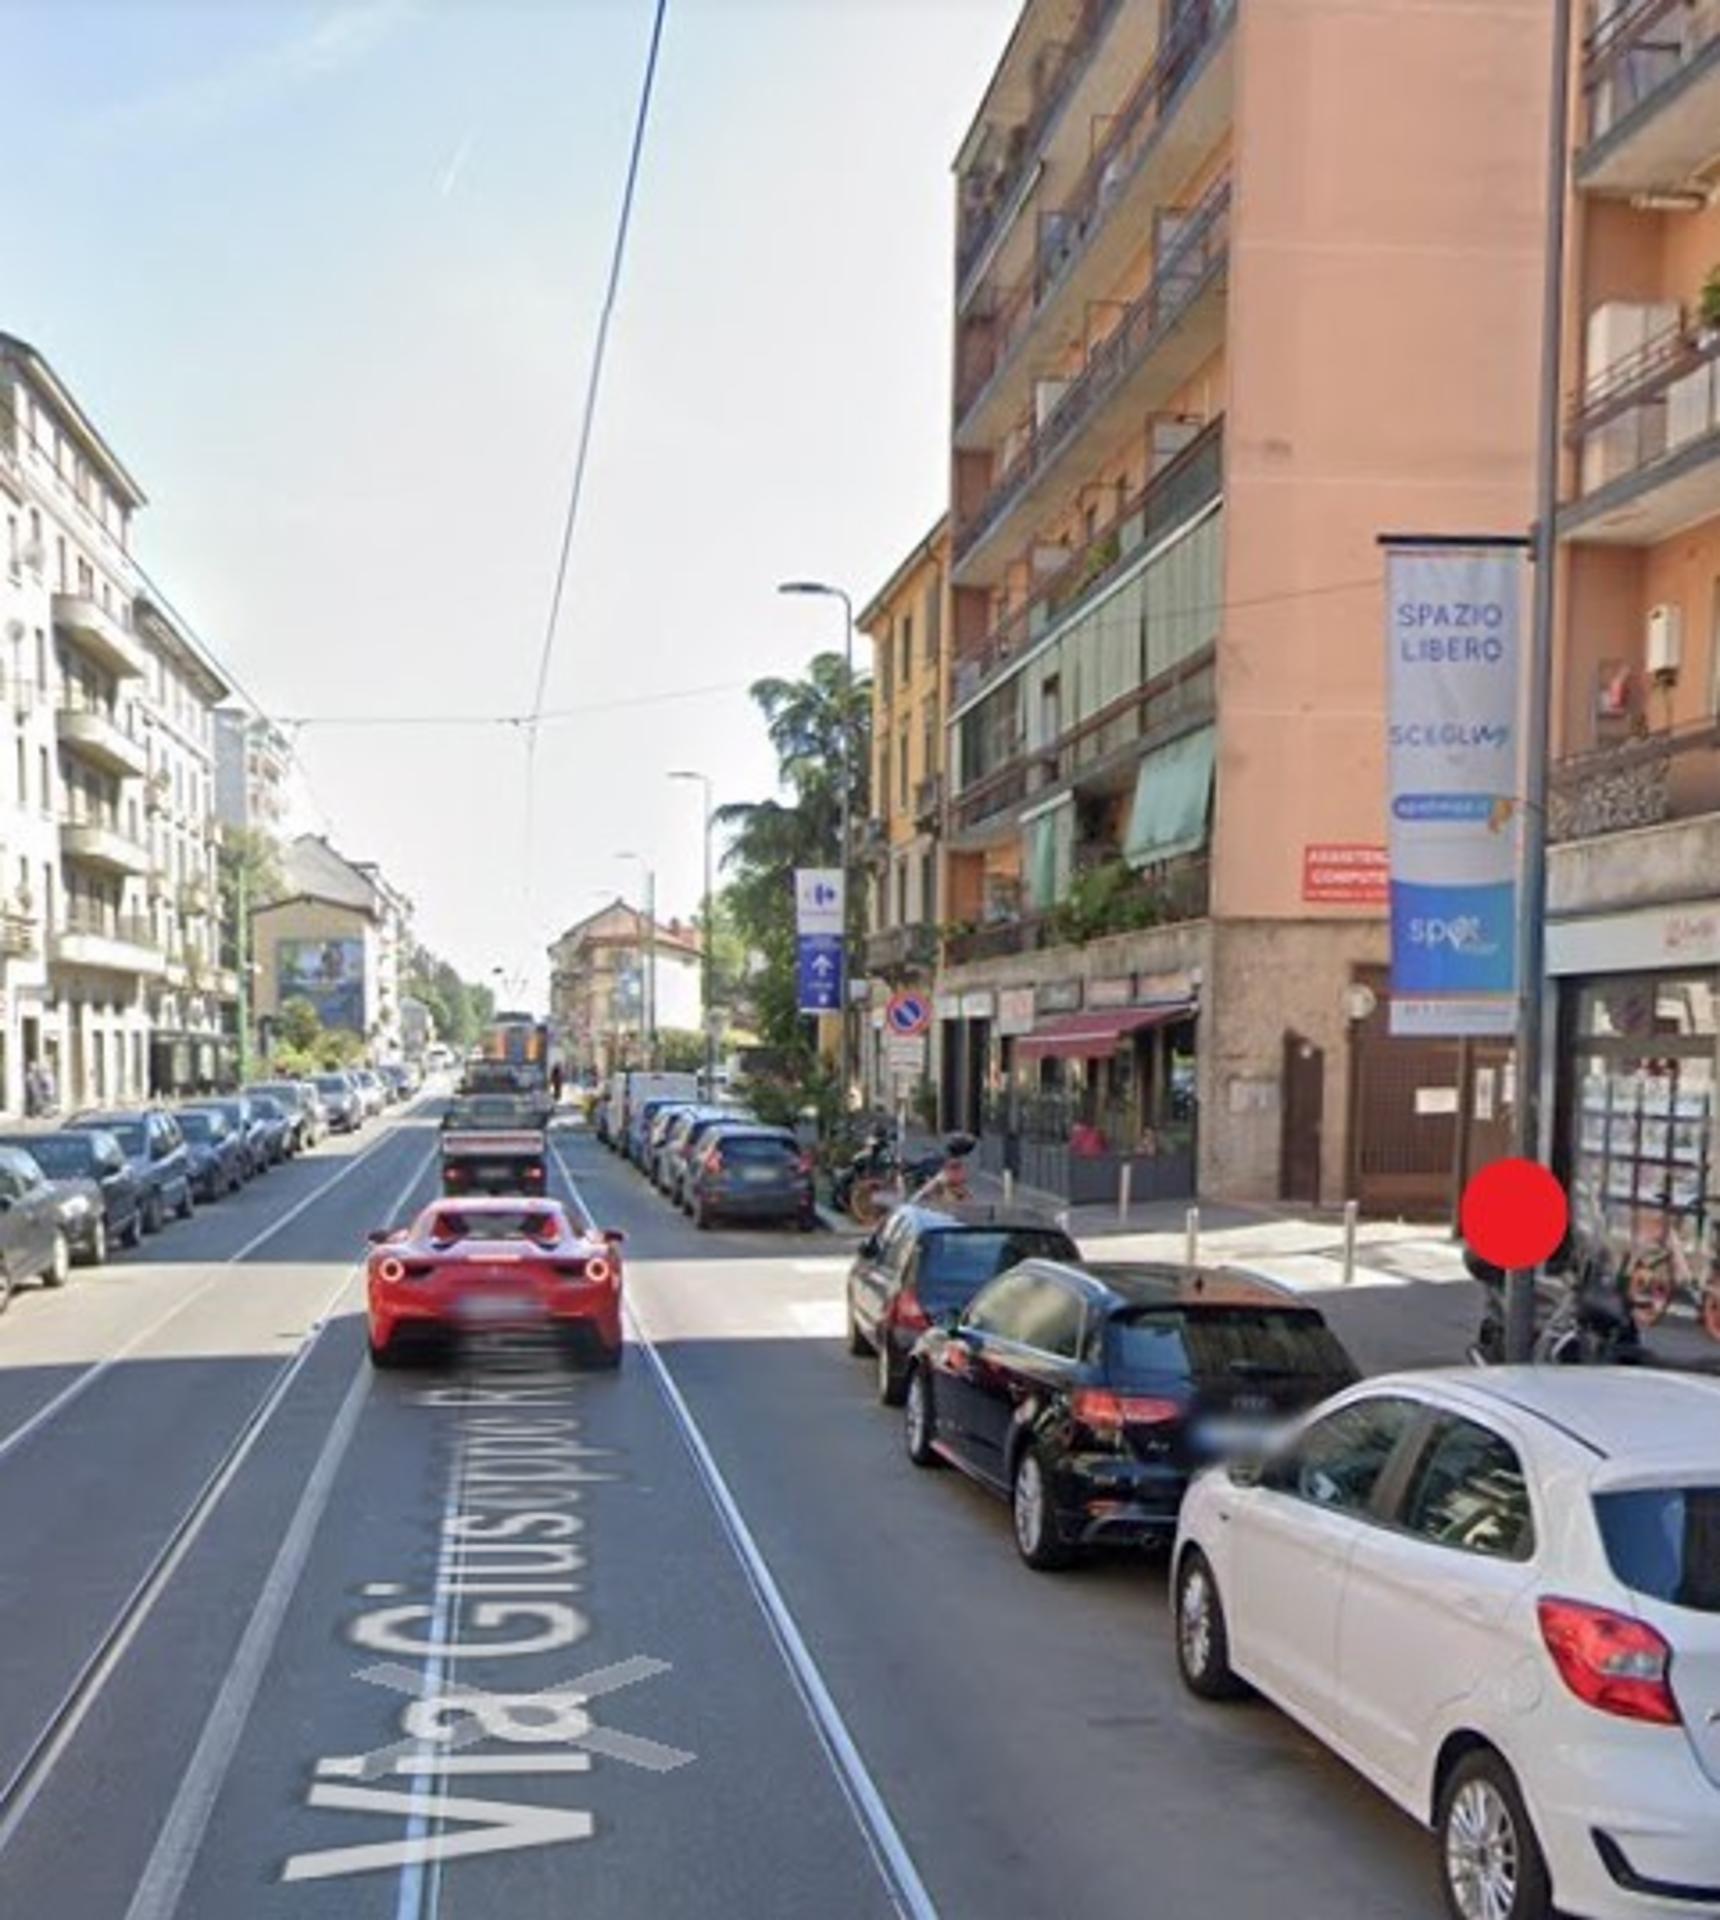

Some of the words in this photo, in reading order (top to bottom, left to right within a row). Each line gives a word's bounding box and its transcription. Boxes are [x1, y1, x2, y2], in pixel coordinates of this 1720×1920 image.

[1398, 603, 1502, 627] SPAZIO
[1401, 636, 1502, 662] LIBERO
[1308, 850, 1386, 864] ASSISTEN
[1311, 869, 1386, 885] COMPUTE
